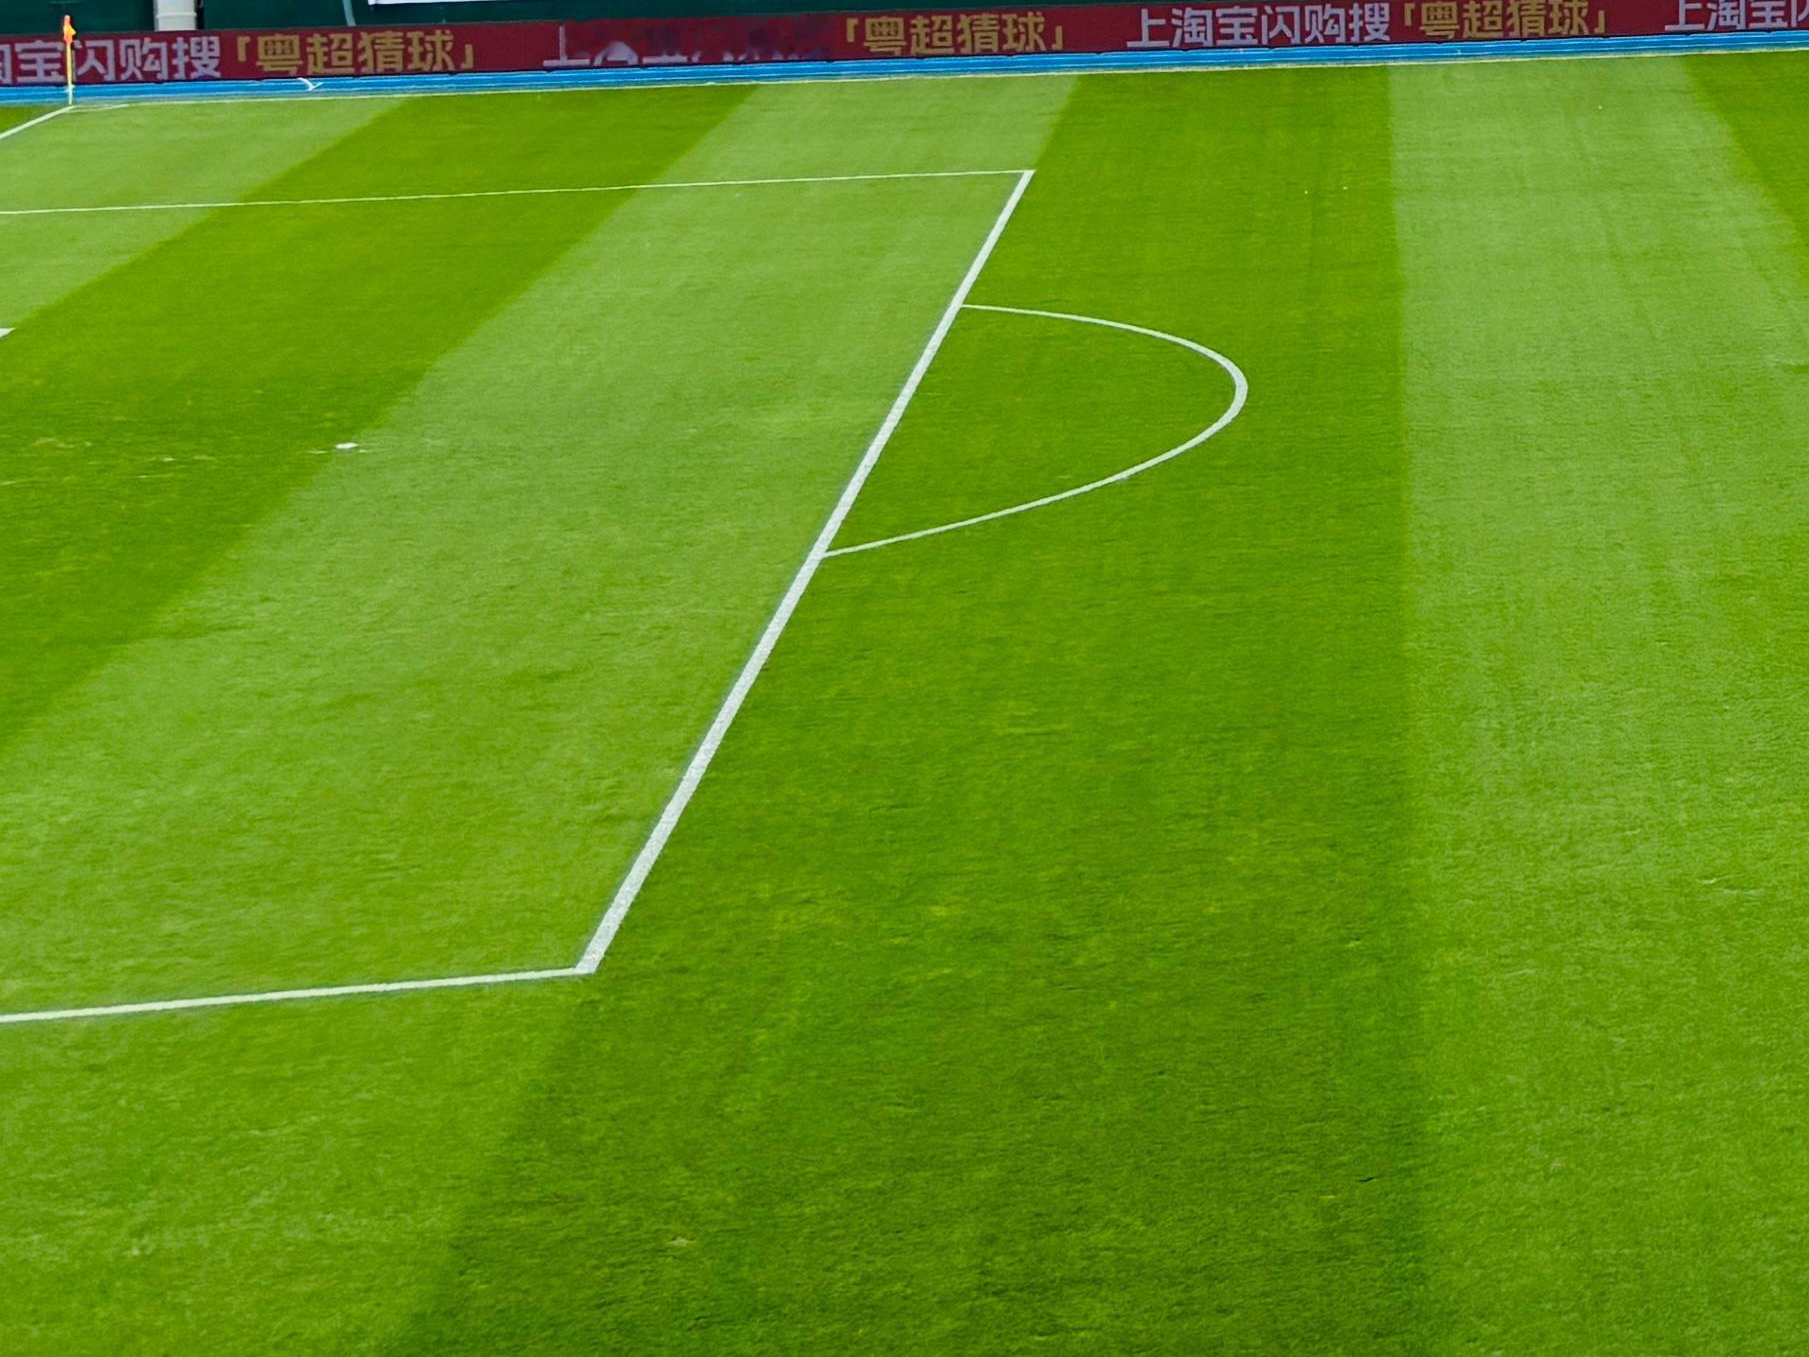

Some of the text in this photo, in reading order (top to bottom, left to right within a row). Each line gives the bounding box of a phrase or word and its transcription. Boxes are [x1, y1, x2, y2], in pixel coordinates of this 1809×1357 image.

[0, 29, 475, 86] 宝闪购搜「粤超猜球」
